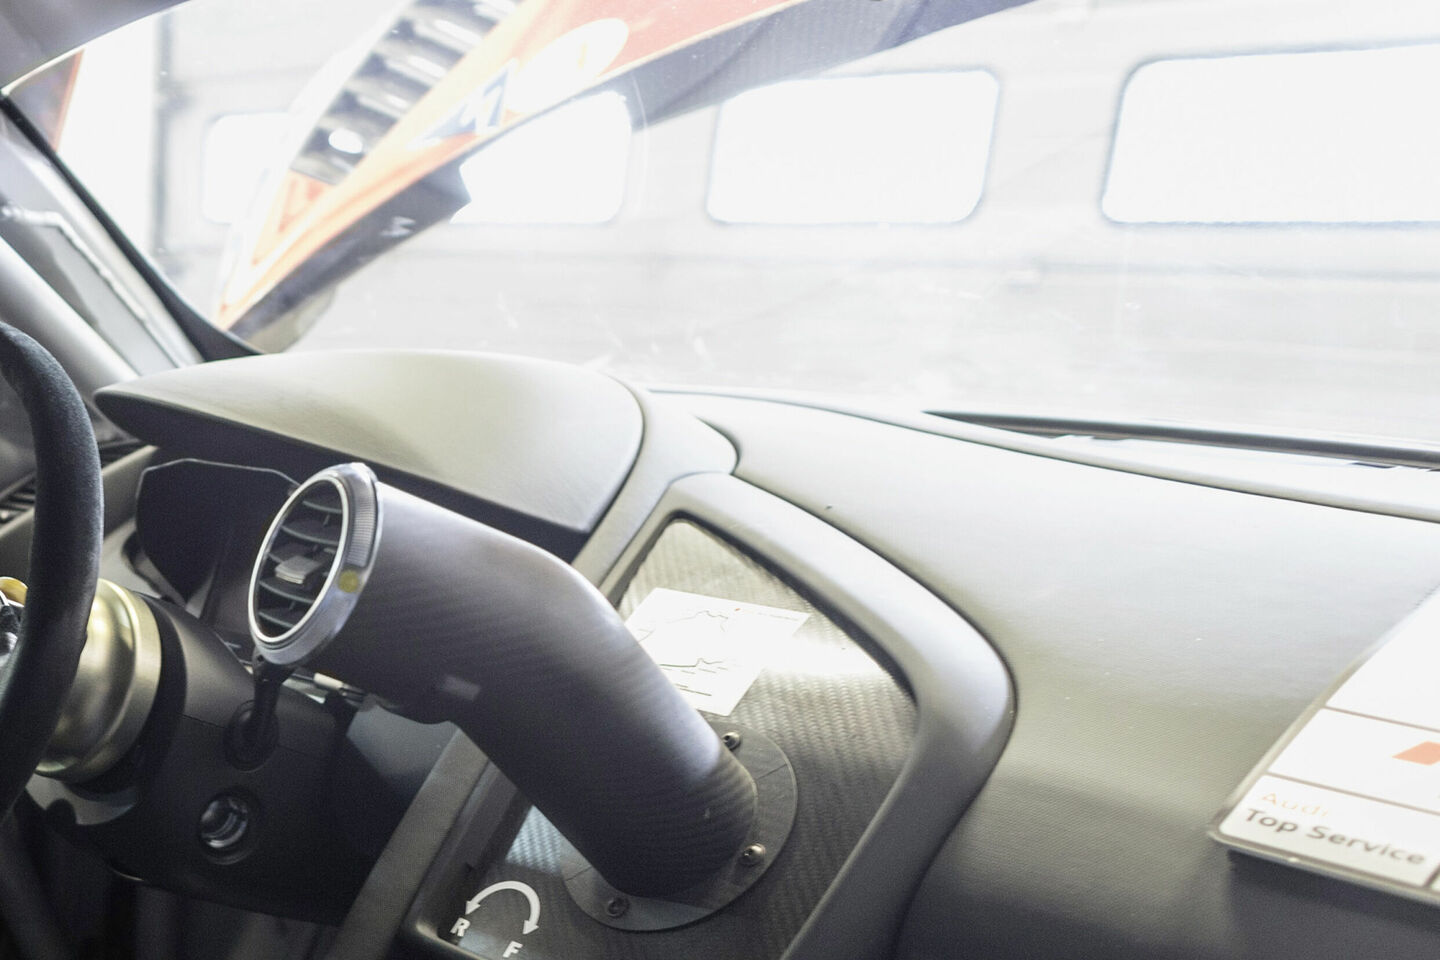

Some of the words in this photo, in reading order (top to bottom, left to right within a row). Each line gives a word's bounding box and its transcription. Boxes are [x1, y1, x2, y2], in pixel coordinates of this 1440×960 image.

[1245, 808, 1299, 834] Top
[1306, 825, 1427, 866] Service
[449, 917, 471, 937] R
[502, 941, 523, 958] F
